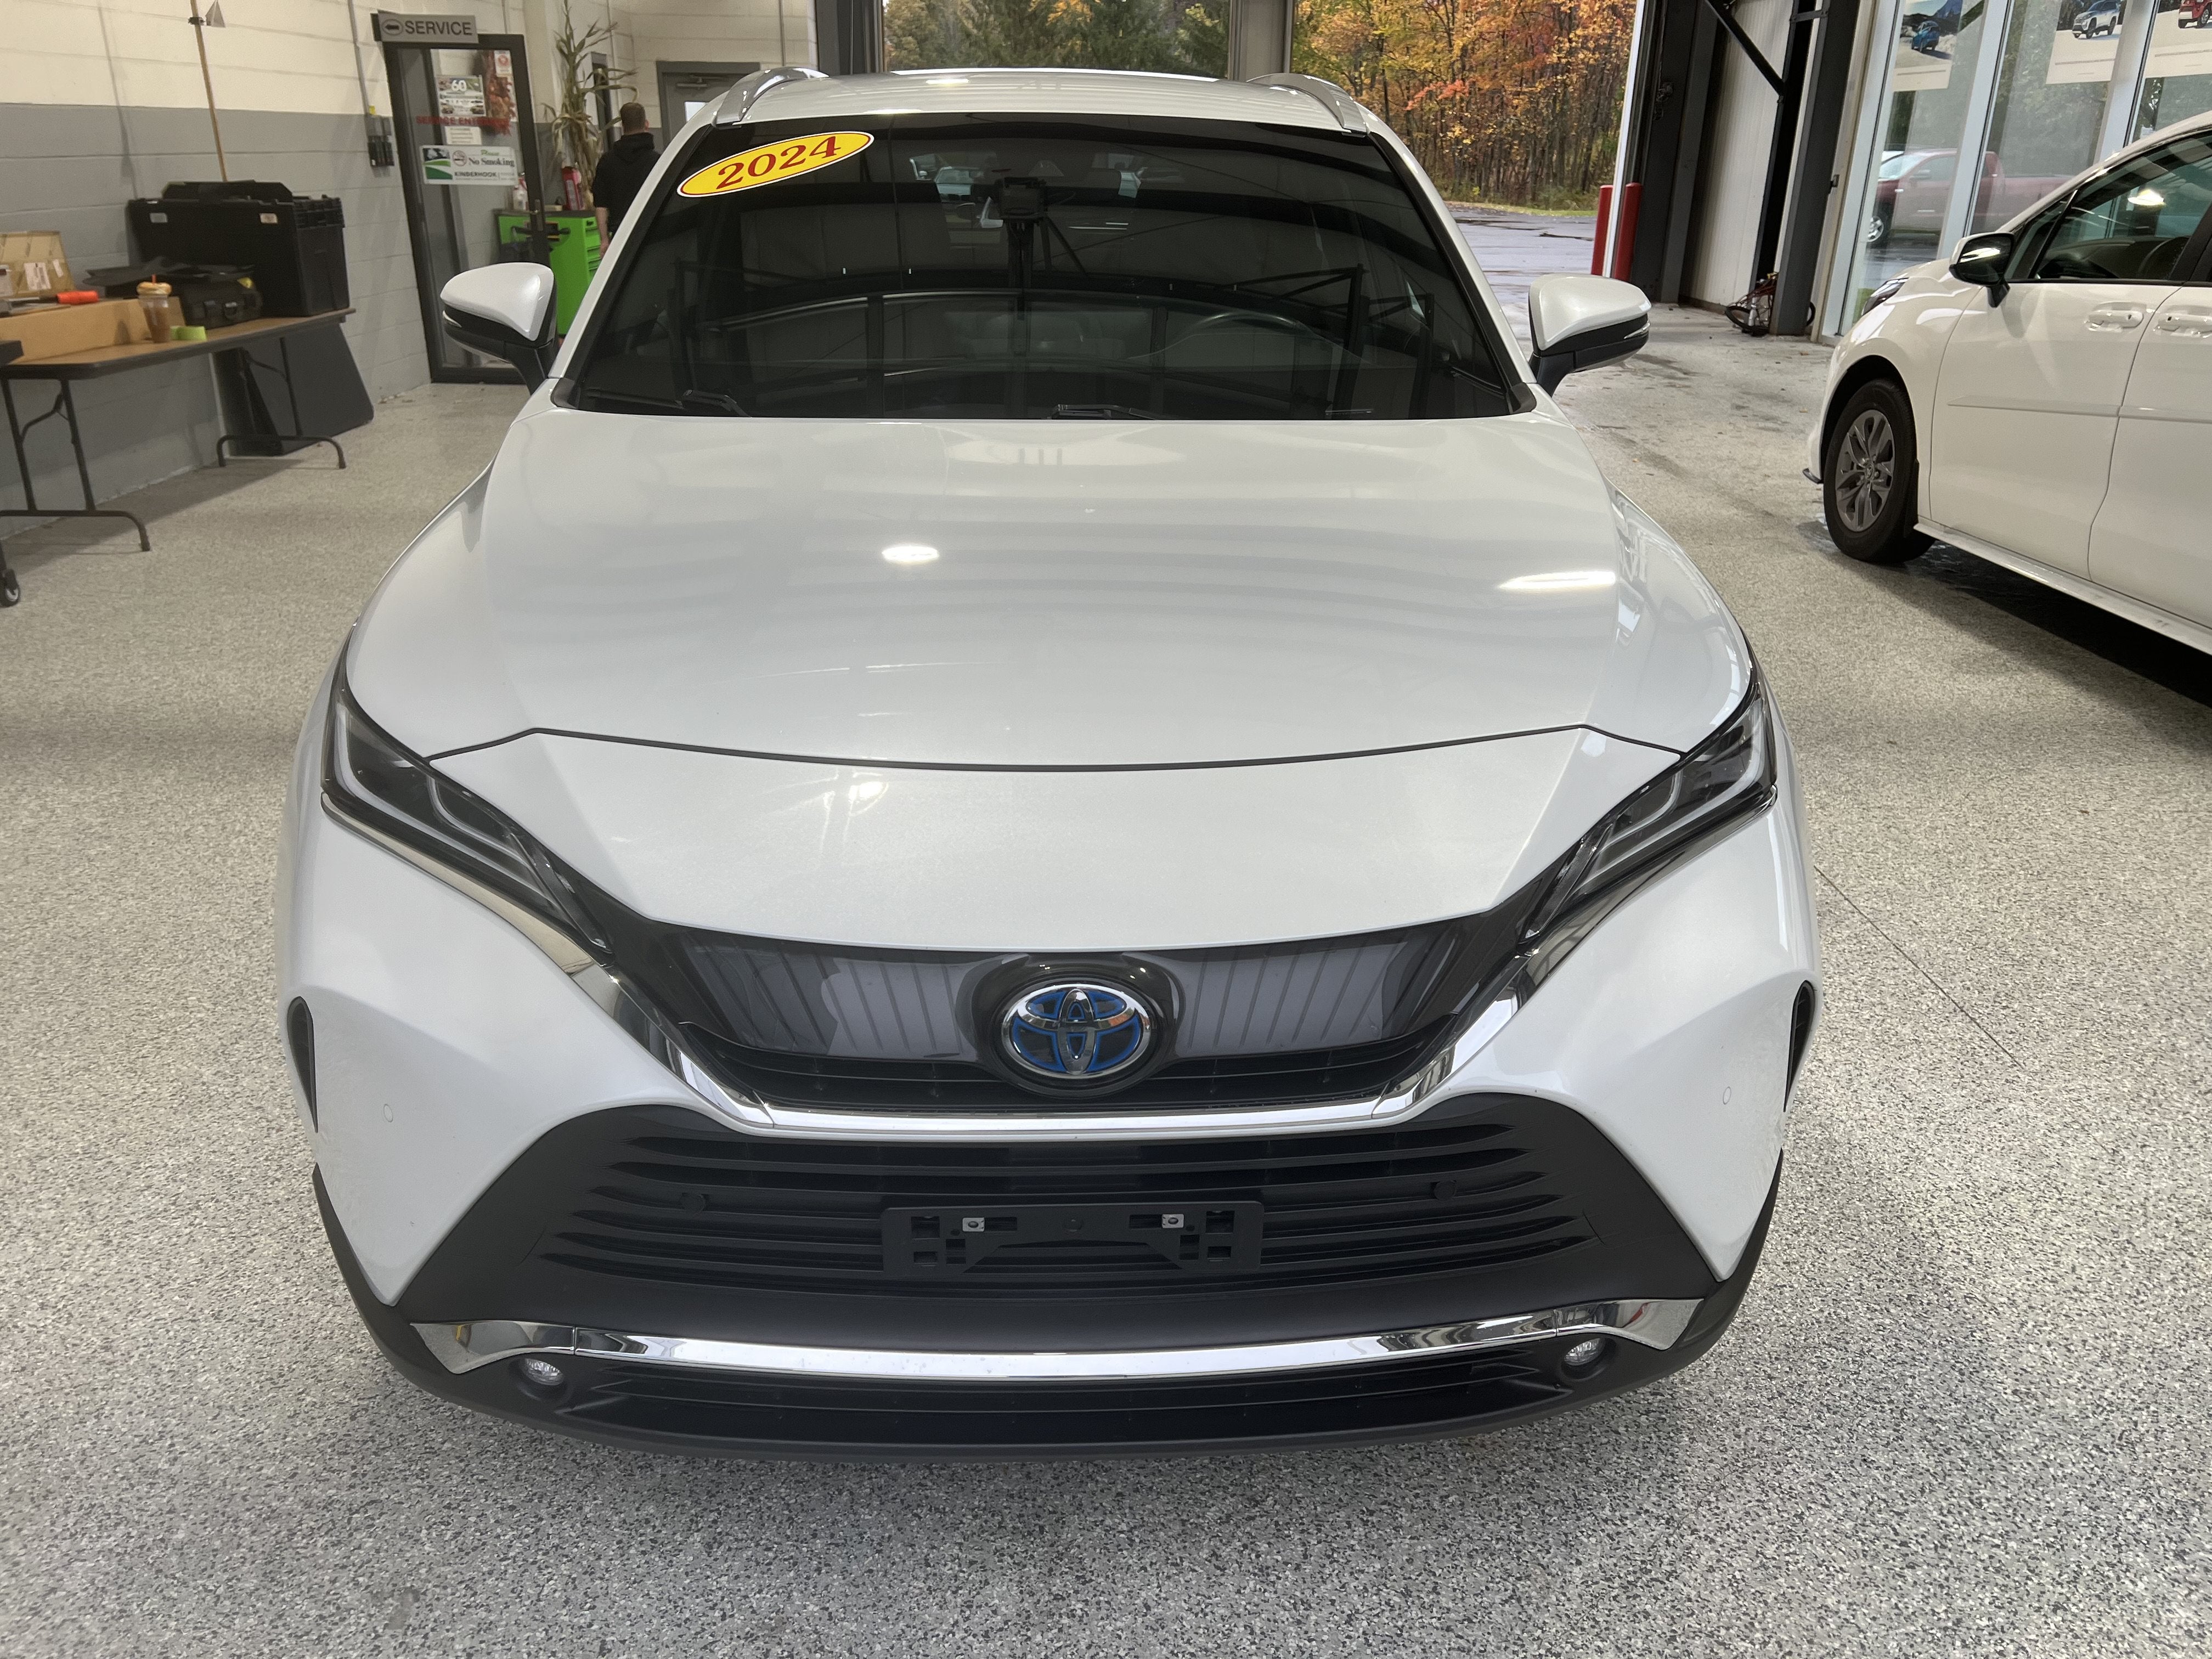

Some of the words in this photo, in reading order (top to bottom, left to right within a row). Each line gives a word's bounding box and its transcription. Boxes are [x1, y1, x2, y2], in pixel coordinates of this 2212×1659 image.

[405, 21, 472, 36] SERVICE
[452, 80, 466, 92] 60
[481, 157, 515, 167] Smoking
[716, 136, 840, 189] 2024
